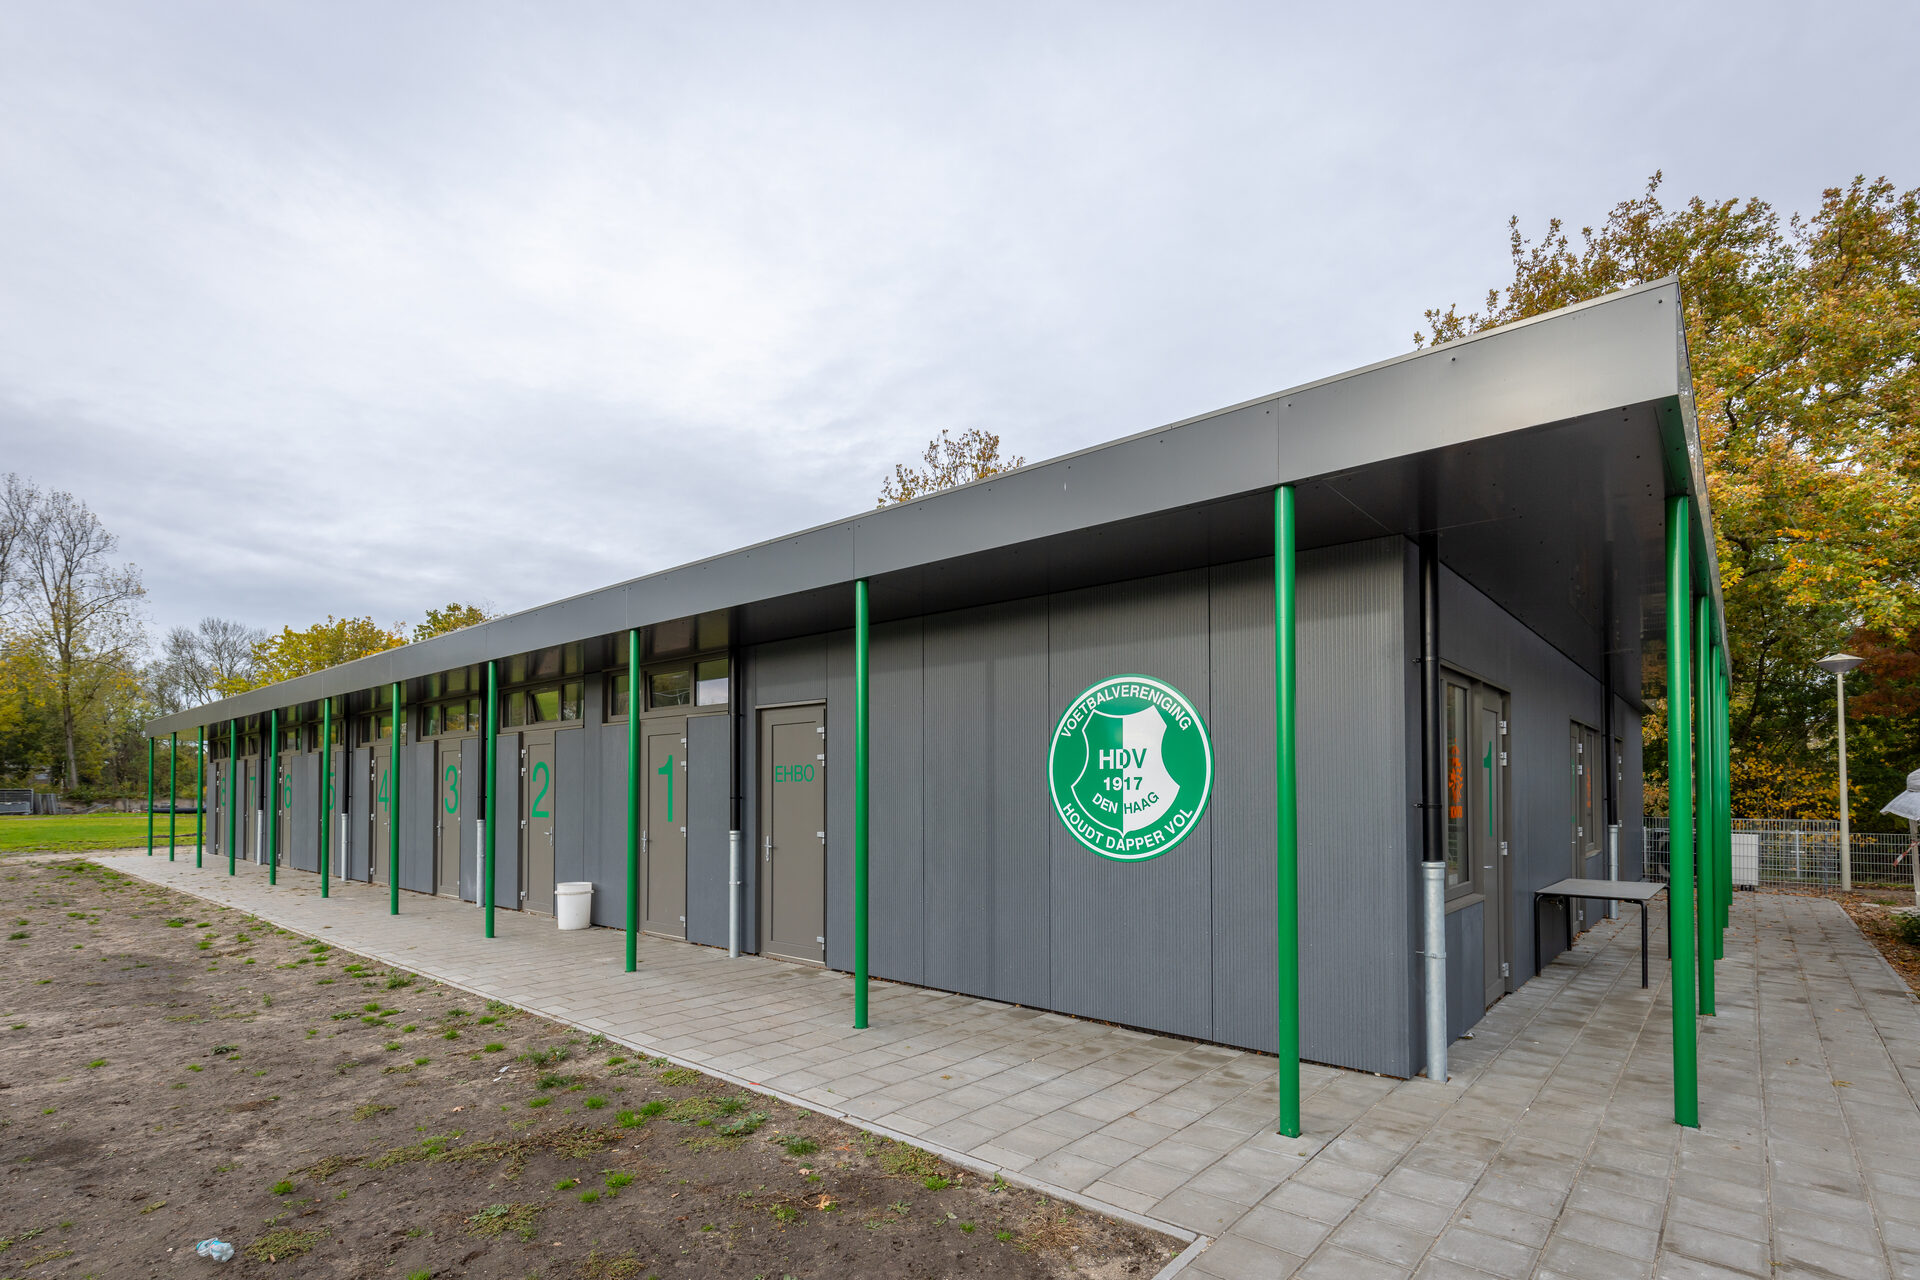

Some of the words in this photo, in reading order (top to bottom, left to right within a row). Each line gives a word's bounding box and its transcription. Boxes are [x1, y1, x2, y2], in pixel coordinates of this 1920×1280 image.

[1061, 684, 1192, 738] VOETBALVERENIGING
[774, 763, 815, 783] EHBO
[1099, 748, 1147, 770] HDV
[249, 776, 256, 808] 7
[284, 773, 292, 809] 6
[378, 768, 389, 813] 4
[444, 764, 459, 815] 3
[531, 761, 550, 818] 2
[657, 754, 674, 823] 1
[1091, 793, 1118, 814] DEN
[1123, 791, 1160, 815] HAAG
[1103, 776, 1143, 791] 1917
[1483, 740, 1493, 837] 1
[1062, 803, 1104, 844] HOUDT
[1105, 830, 1165, 851] DAPPER
[1164, 808, 1194, 835] VOL
